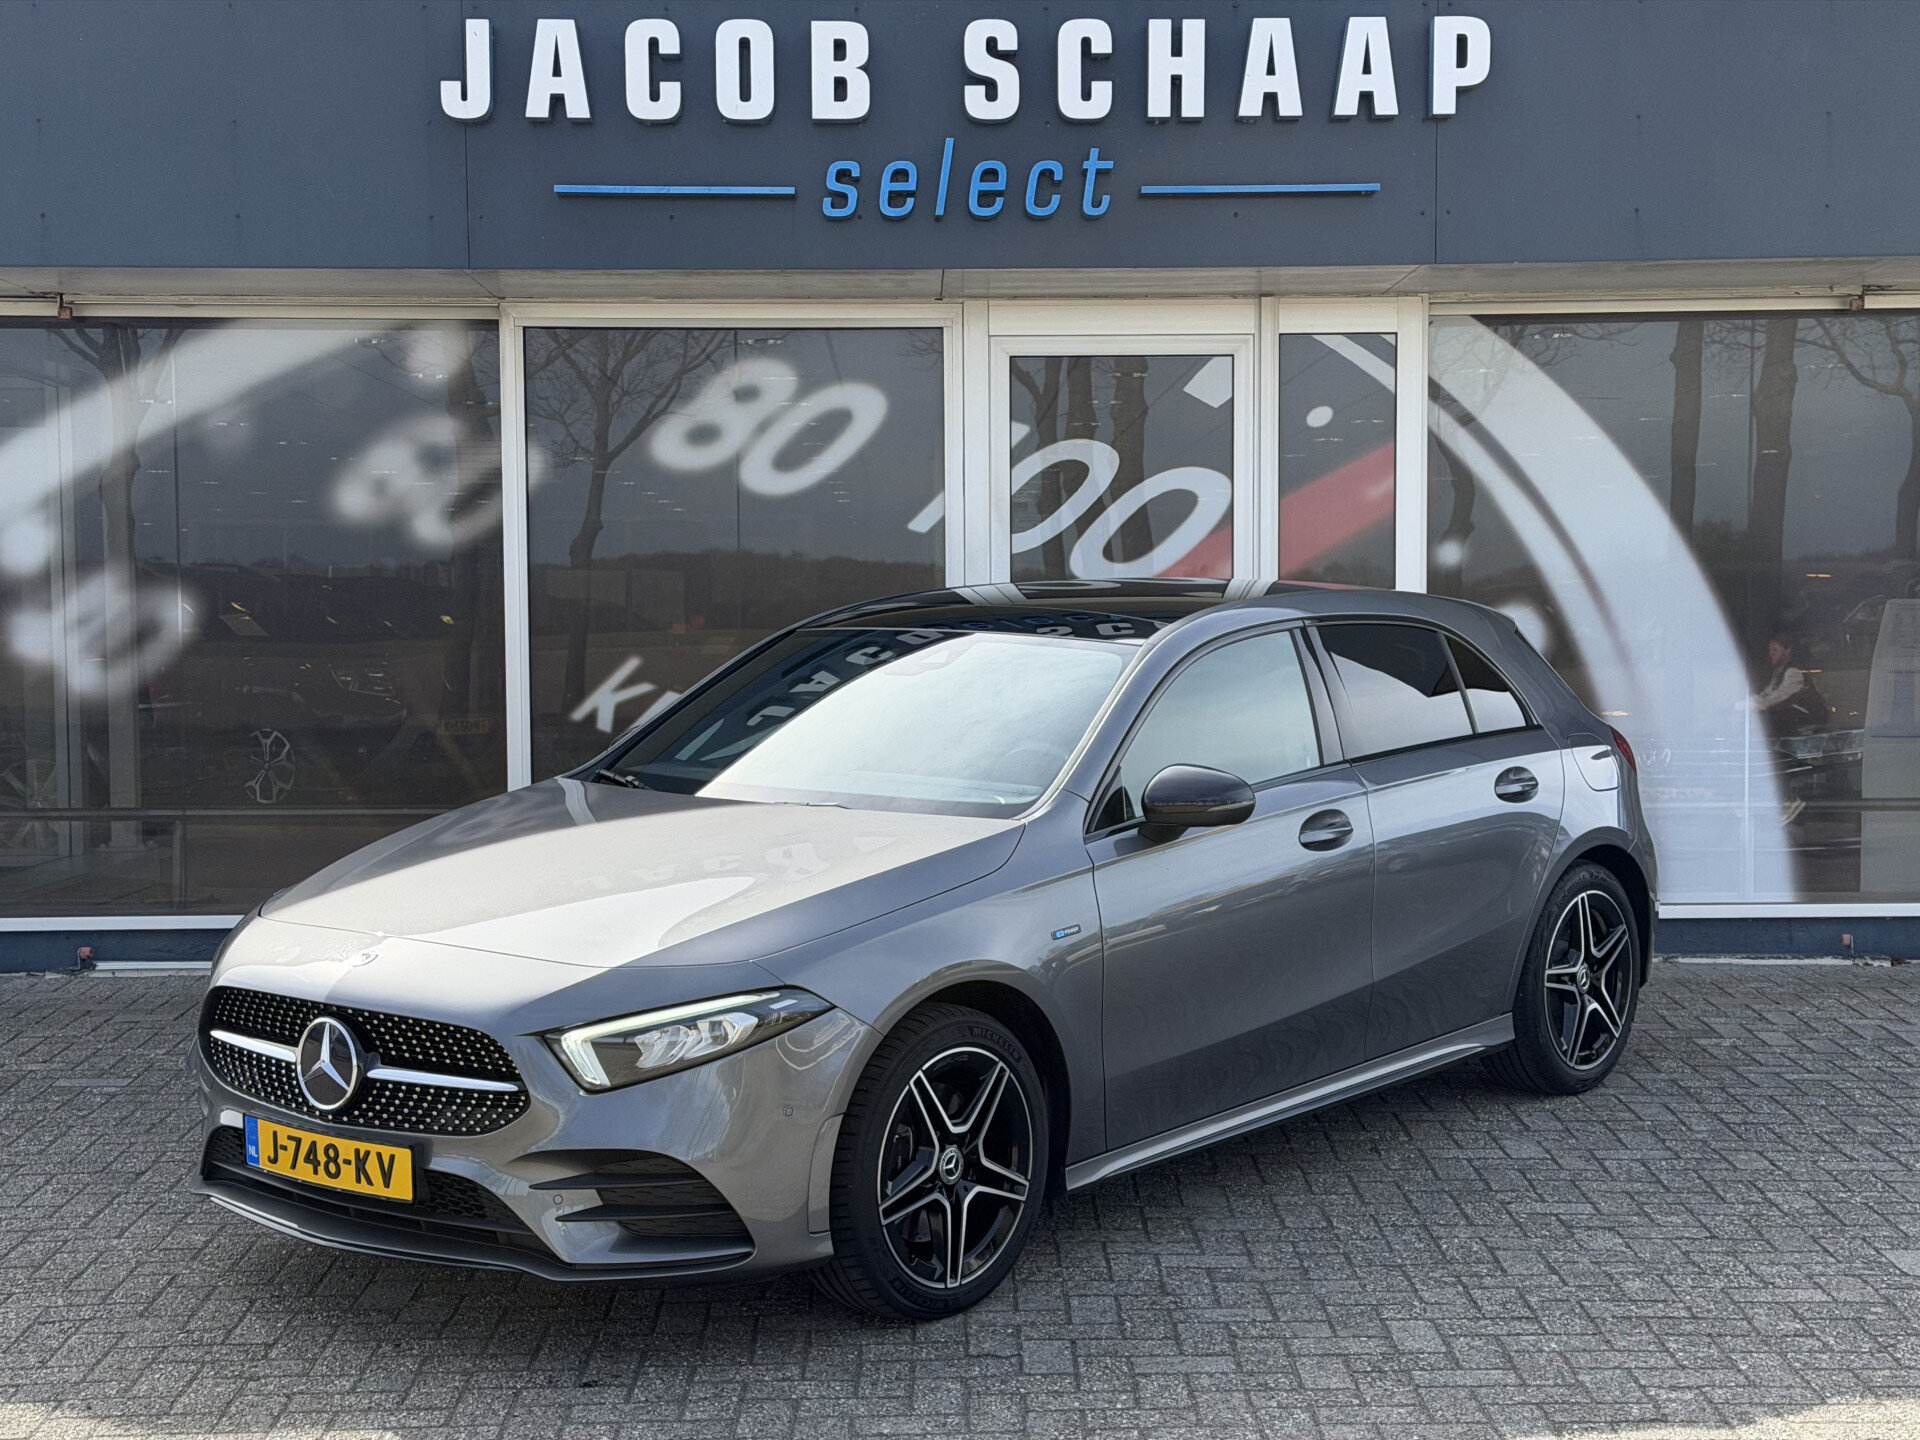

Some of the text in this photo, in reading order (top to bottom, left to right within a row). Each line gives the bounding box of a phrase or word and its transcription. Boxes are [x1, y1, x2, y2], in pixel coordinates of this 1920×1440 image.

[440, 16, 1492, 121] JACOB SCHAAP
[822, 137, 1114, 218] select
[649, 357, 888, 497] 80
[248, 1130, 396, 1189] NL J-748-KV
